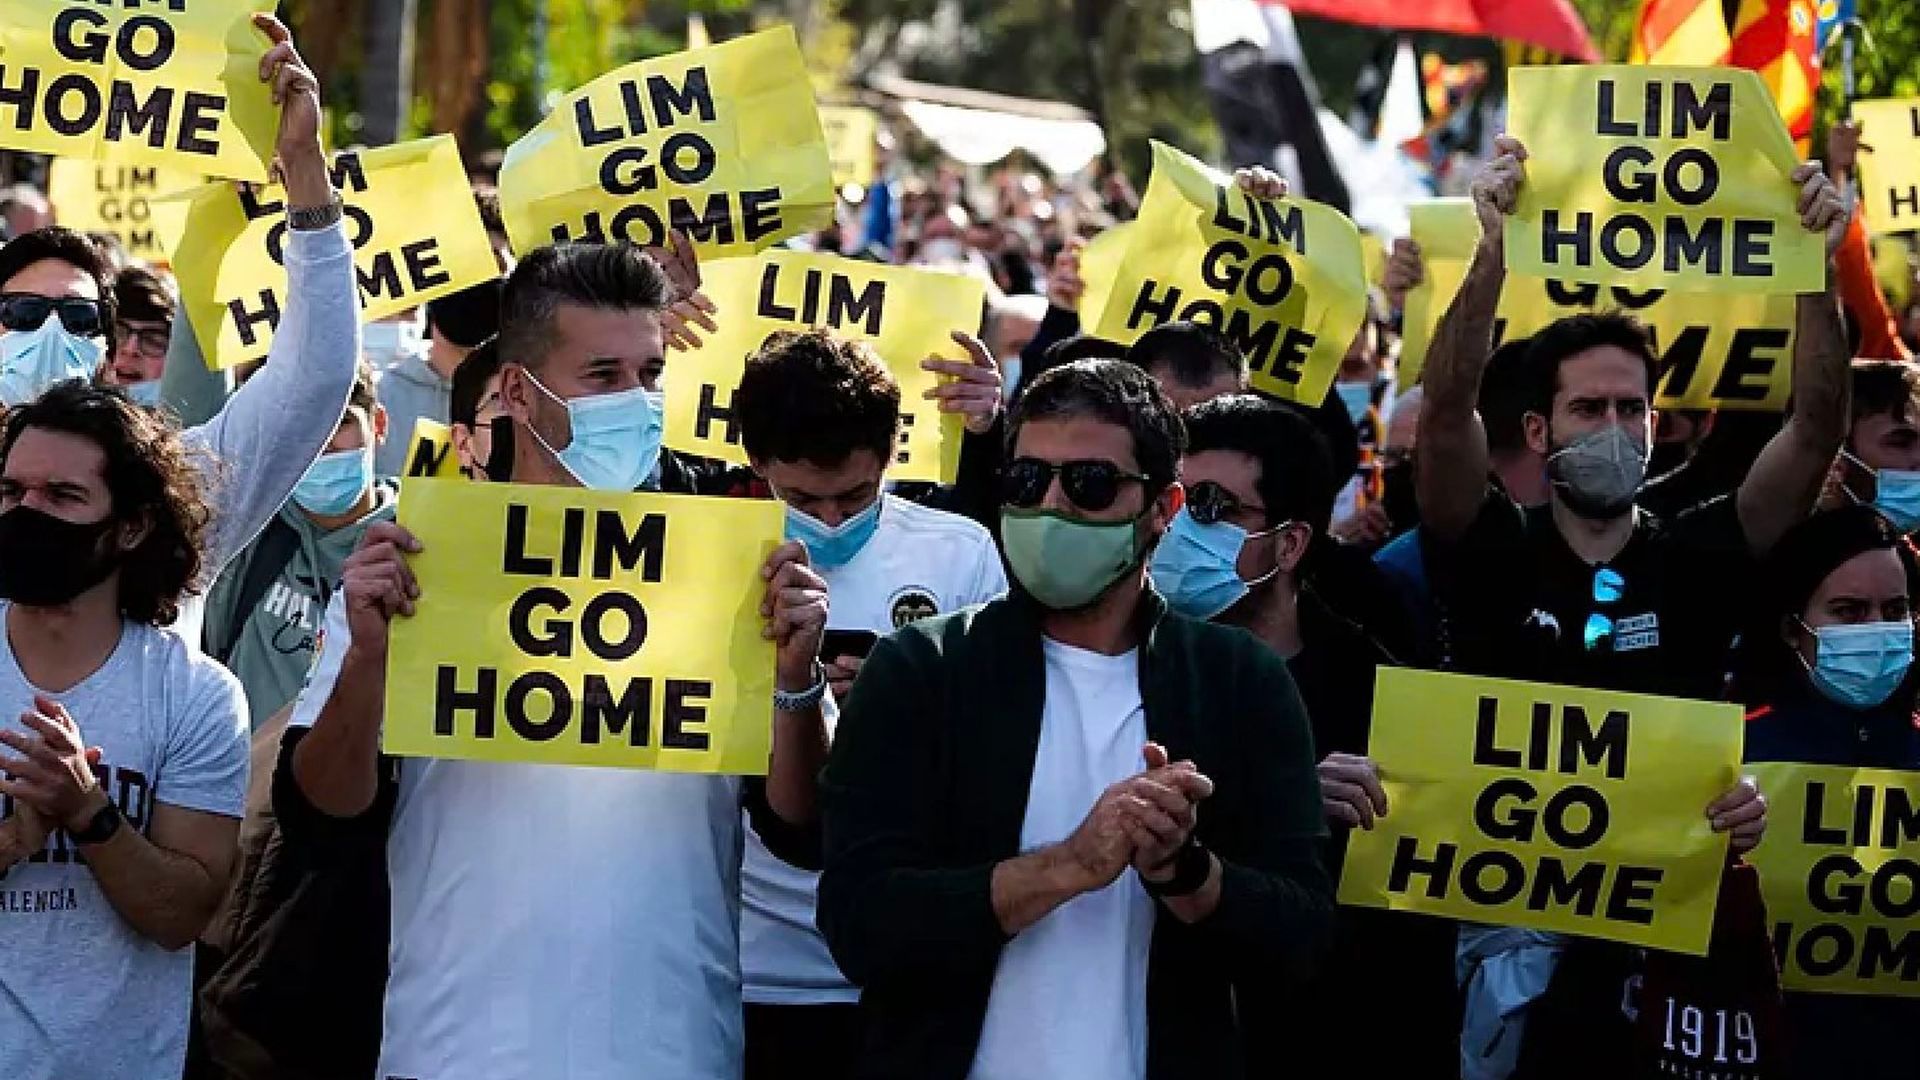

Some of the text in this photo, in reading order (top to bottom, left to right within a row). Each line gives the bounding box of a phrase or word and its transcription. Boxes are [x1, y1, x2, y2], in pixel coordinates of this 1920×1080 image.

[53, 8, 175, 71] GO
[0, 65, 226, 155] HOME
[574, 66, 716, 147] LIM
[1598, 80, 1732, 140] LIM
[96, 165, 157, 191] LIM
[238, 152, 368, 221] LM
[599, 132, 716, 196] GO
[1603, 146, 1720, 204] GO
[99, 196, 150, 223] GO
[1213, 186, 1306, 255] LIM
[1541, 210, 1774, 277] HOME
[228, 236, 450, 346] HME
[757, 264, 886, 336] LIM
[1202, 239, 1293, 305] GO
[504, 504, 666, 583] LIM
[509, 587, 649, 660] GO
[434, 666, 712, 751] HOME
[1474, 697, 1630, 780] LIM
[1474, 779, 1609, 849] GO
[1803, 782, 1920, 849] LIM
[1388, 837, 1665, 925] HOME
[1808, 853, 1920, 918] GO
[1663, 996, 1758, 1064] 1919
